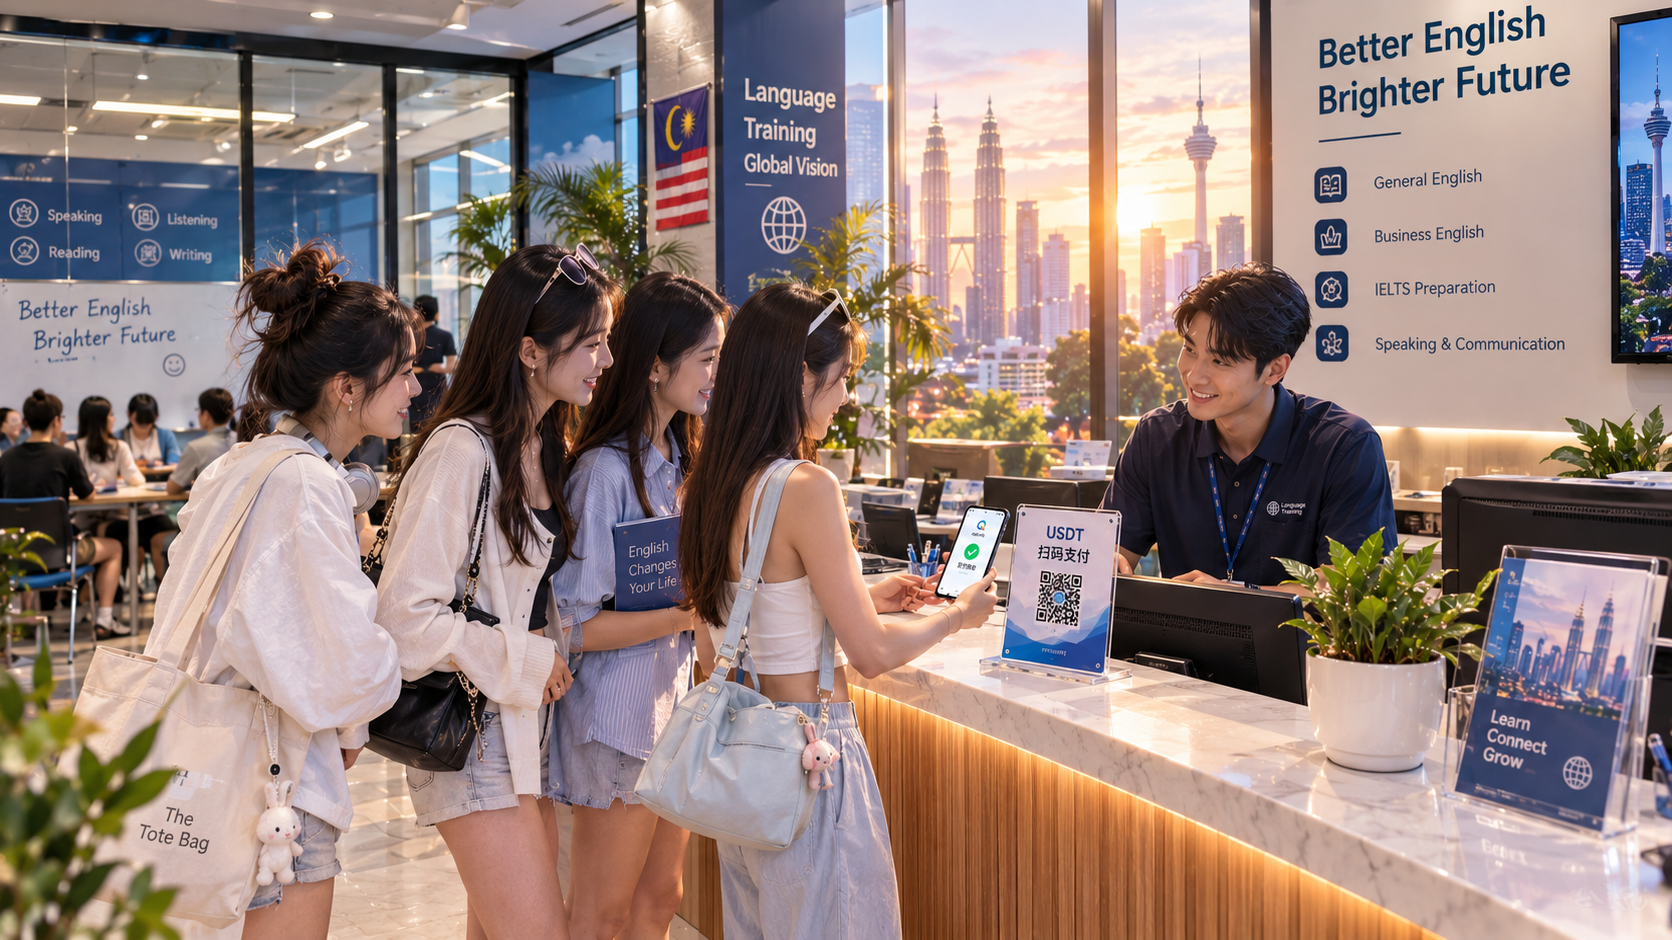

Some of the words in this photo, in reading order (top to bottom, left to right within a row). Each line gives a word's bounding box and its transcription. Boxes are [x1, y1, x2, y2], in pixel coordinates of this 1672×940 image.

[1319, 33, 1413, 69] Better
[1425, 5, 1545, 56] English
[744, 77, 837, 113] Language
[1319, 76, 1445, 118] Brighter
[1457, 62, 1571, 99] Future
[743, 116, 817, 149] Training
[744, 153, 793, 175] Global
[796, 156, 838, 177] Vision
[1373, 172, 1427, 190] General
[1432, 168, 1482, 188] English
[48, 209, 102, 225] Speaking
[167, 213, 218, 229] Listening
[1374, 228, 1431, 243] Business
[1436, 224, 1484, 243] English
[49, 246, 100, 262] Reading
[169, 248, 212, 264] Writing
[1375, 281, 1411, 296] IELTS
[1415, 280, 1496, 298] Preparation
[18, 299, 78, 321] Better
[88, 297, 151, 324] English
[33, 328, 112, 356] Brighter
[121, 326, 176, 345] Future
[1375, 337, 1437, 354] Speaking
[1441, 337, 1451, 351] &
[1455, 337, 1566, 351] Communication
[1046, 525, 1085, 542] USDT
[629, 540, 669, 559] English
[1037, 544, 1091, 564] 扫码支付
[628, 559, 677, 577] Changes
[629, 581, 656, 594] Your
[658, 575, 677, 590] Life
[1490, 709, 1531, 731] Learn
[1487, 728, 1548, 756] Connect
[1483, 747, 1524, 769] Grow
[165, 806, 194, 827] The
[139, 823, 174, 845] Tote
[178, 831, 210, 855] Bag
